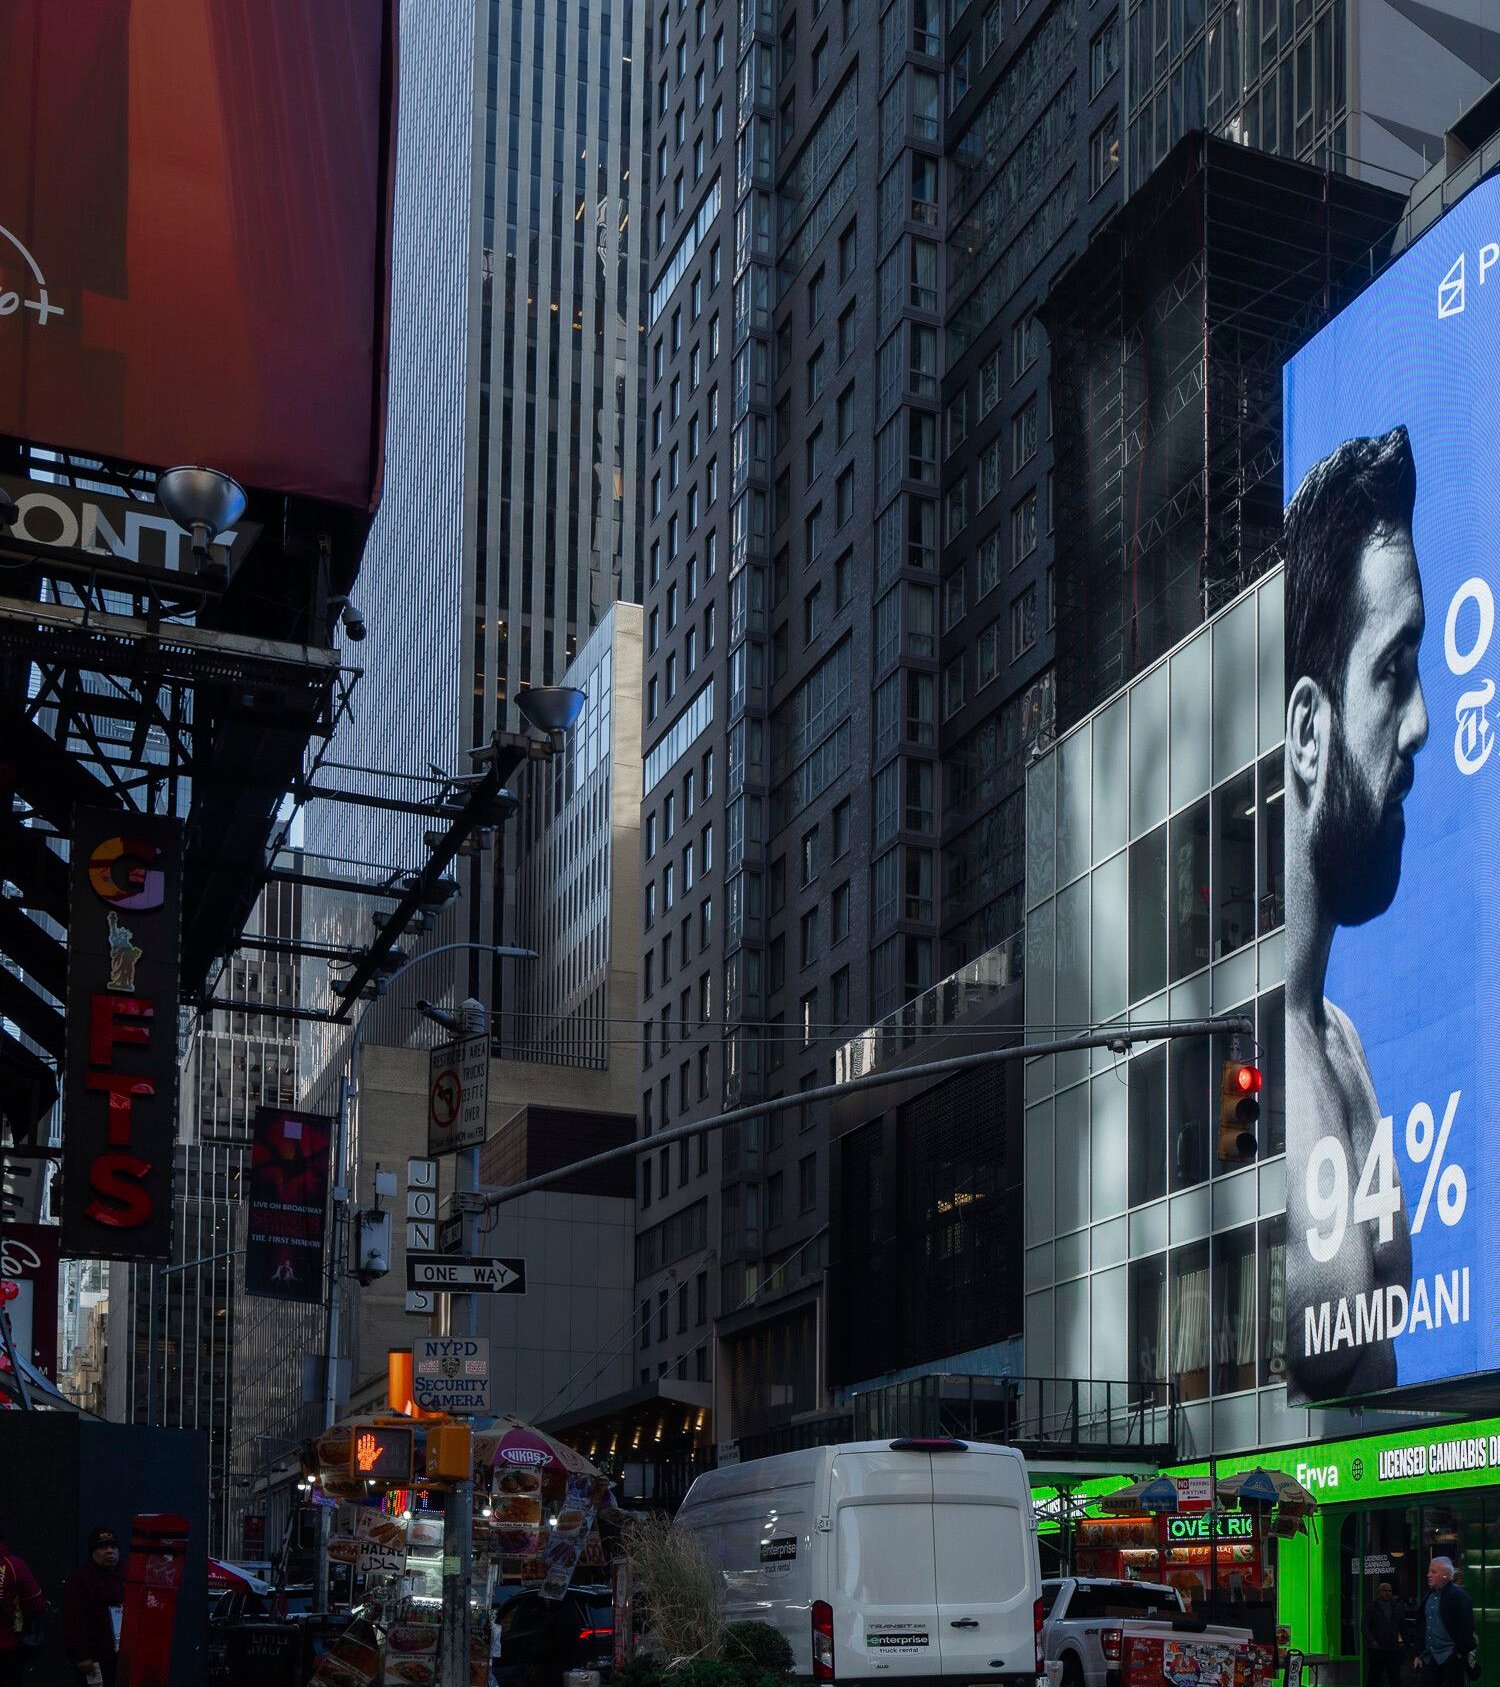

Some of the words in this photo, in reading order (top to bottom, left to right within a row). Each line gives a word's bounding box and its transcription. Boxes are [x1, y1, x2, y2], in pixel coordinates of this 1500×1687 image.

[469, 1042, 486, 1060] AREA
[463, 1063, 485, 1082] TRUCKS
[464, 1106, 480, 1123] OVER
[1304, 1089, 1467, 1264] 94%
[253, 1200, 268, 1209] LIVE
[269, 1202, 281, 1210] ON
[282, 1203, 323, 1215] BROADWAY
[251, 1233, 266, 1242] THE
[424, 1266, 458, 1282] ONE
[474, 1267, 508, 1283] WAY
[1302, 1265, 1473, 1358] MAMDANI
[425, 1342, 478, 1357] NYPD
[415, 1377, 489, 1392] SECURITY
[418, 1391, 485, 1408] CAMERA
[508, 1450, 542, 1462] NIKAS
[1295, 1462, 1340, 1490] Erva
[1378, 1444, 1428, 1482] LICENSED
[1428, 1436, 1488, 1476] CANNABIS
[1178, 1480, 1189, 1489] NO
[1171, 1519, 1224, 1537] OVER
[361, 1542, 404, 1558] HALAL
[361, 1556, 401, 1572] حلال
[869, 1635, 929, 1646] enterprise
